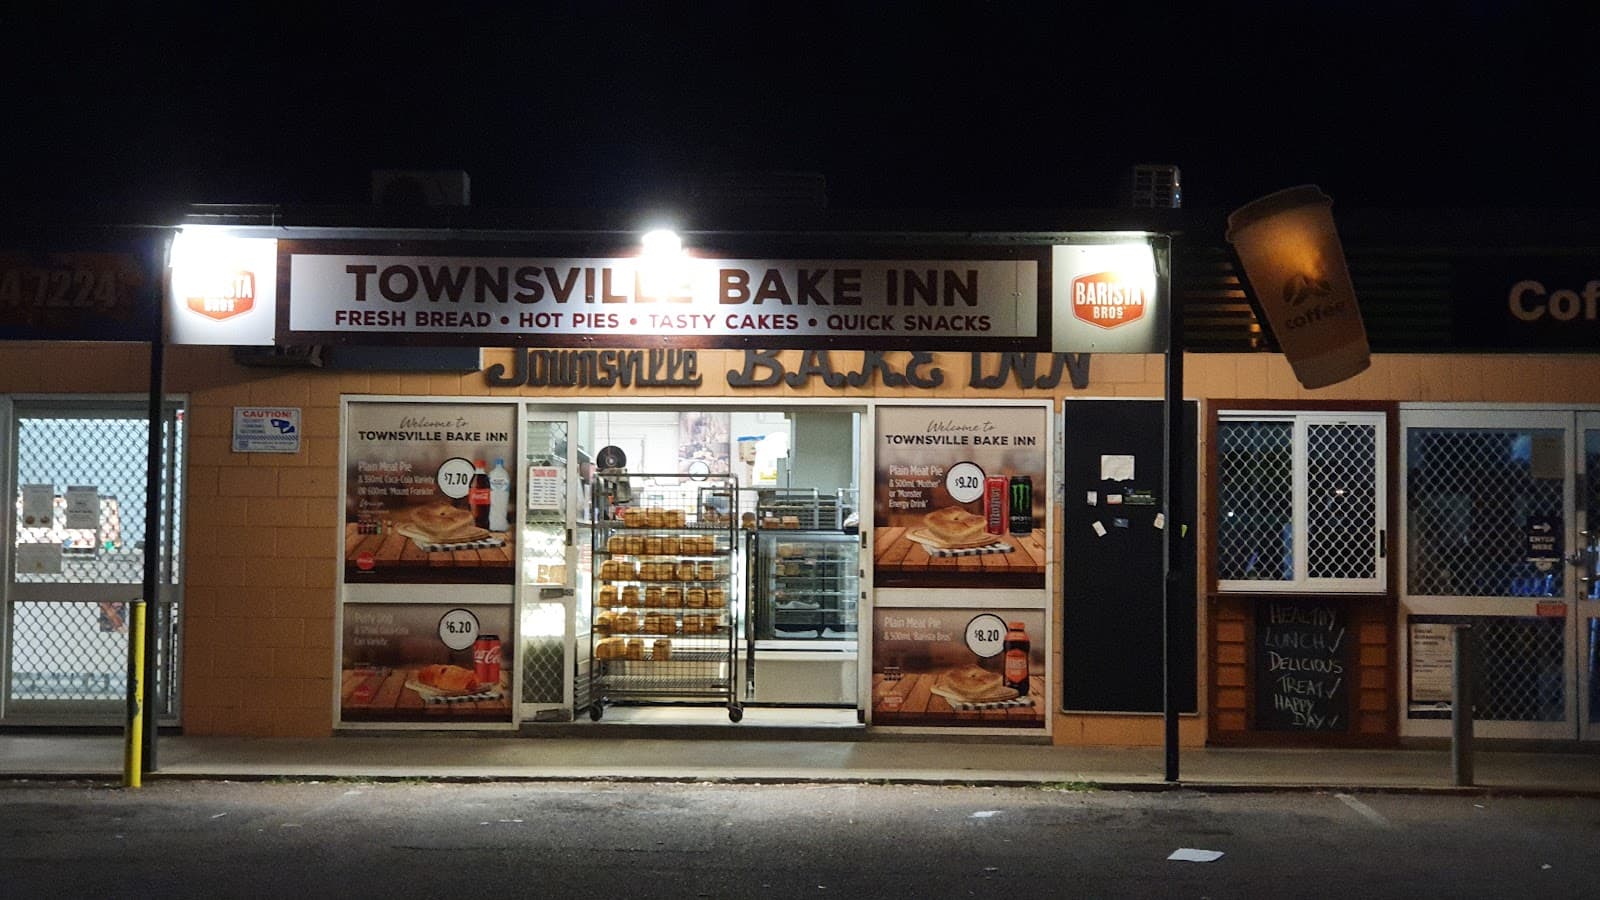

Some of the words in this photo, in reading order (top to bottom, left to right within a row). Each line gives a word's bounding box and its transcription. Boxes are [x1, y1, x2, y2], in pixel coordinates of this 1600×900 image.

[718, 268, 863, 306] BAKE
[887, 269, 979, 307] INN
[1075, 282, 1142, 305] BARISTA
[1093, 306, 1124, 319] BROS
[335, 310, 406, 327] FRESH
[415, 311, 491, 328] BREAD
[520, 312, 564, 329] HOT
[573, 313, 620, 329] PIES
[648, 313, 716, 329] TASTY
[725, 314, 799, 330] CAKES
[827, 314, 896, 331] QUICK
[904, 314, 991, 331] SNACKS
[400, 416, 453, 429] Welcome
[455, 416, 469, 428] to
[927, 420, 979, 433] Welcome
[983, 421, 997, 432] to
[358, 431, 442, 441] TOWNSVILLE
[446, 432, 481, 441] BAKE
[486, 432, 508, 442] INN
[886, 435, 969, 446] TOWNSVILLE
[974, 436, 1008, 446] BAKE
[1014, 436, 1036, 446] INN
[358, 461, 378, 472] Plain
[379, 461, 398, 472] Meat
[399, 461, 412, 472] Pie
[889, 465, 909, 476] Plain
[910, 465, 929, 477] Meat
[930, 465, 943, 477] Pie
[444, 473, 468, 486] $7.70
[955, 476, 979, 489] $9.20
[889, 499, 909, 510] Energy
[885, 616, 904, 628] Plain
[1270, 603, 1336, 630] HEALTHY
[446, 621, 471, 634] $6.20
[974, 629, 999, 642] $8.20
[1264, 627, 1324, 649] LUNCH
[1268, 651, 1343, 674] DELICIOUS
[1277, 673, 1323, 698] TREAT
[1274, 694, 1314, 714] HAPPY
[1292, 711, 1326, 729] DAY
